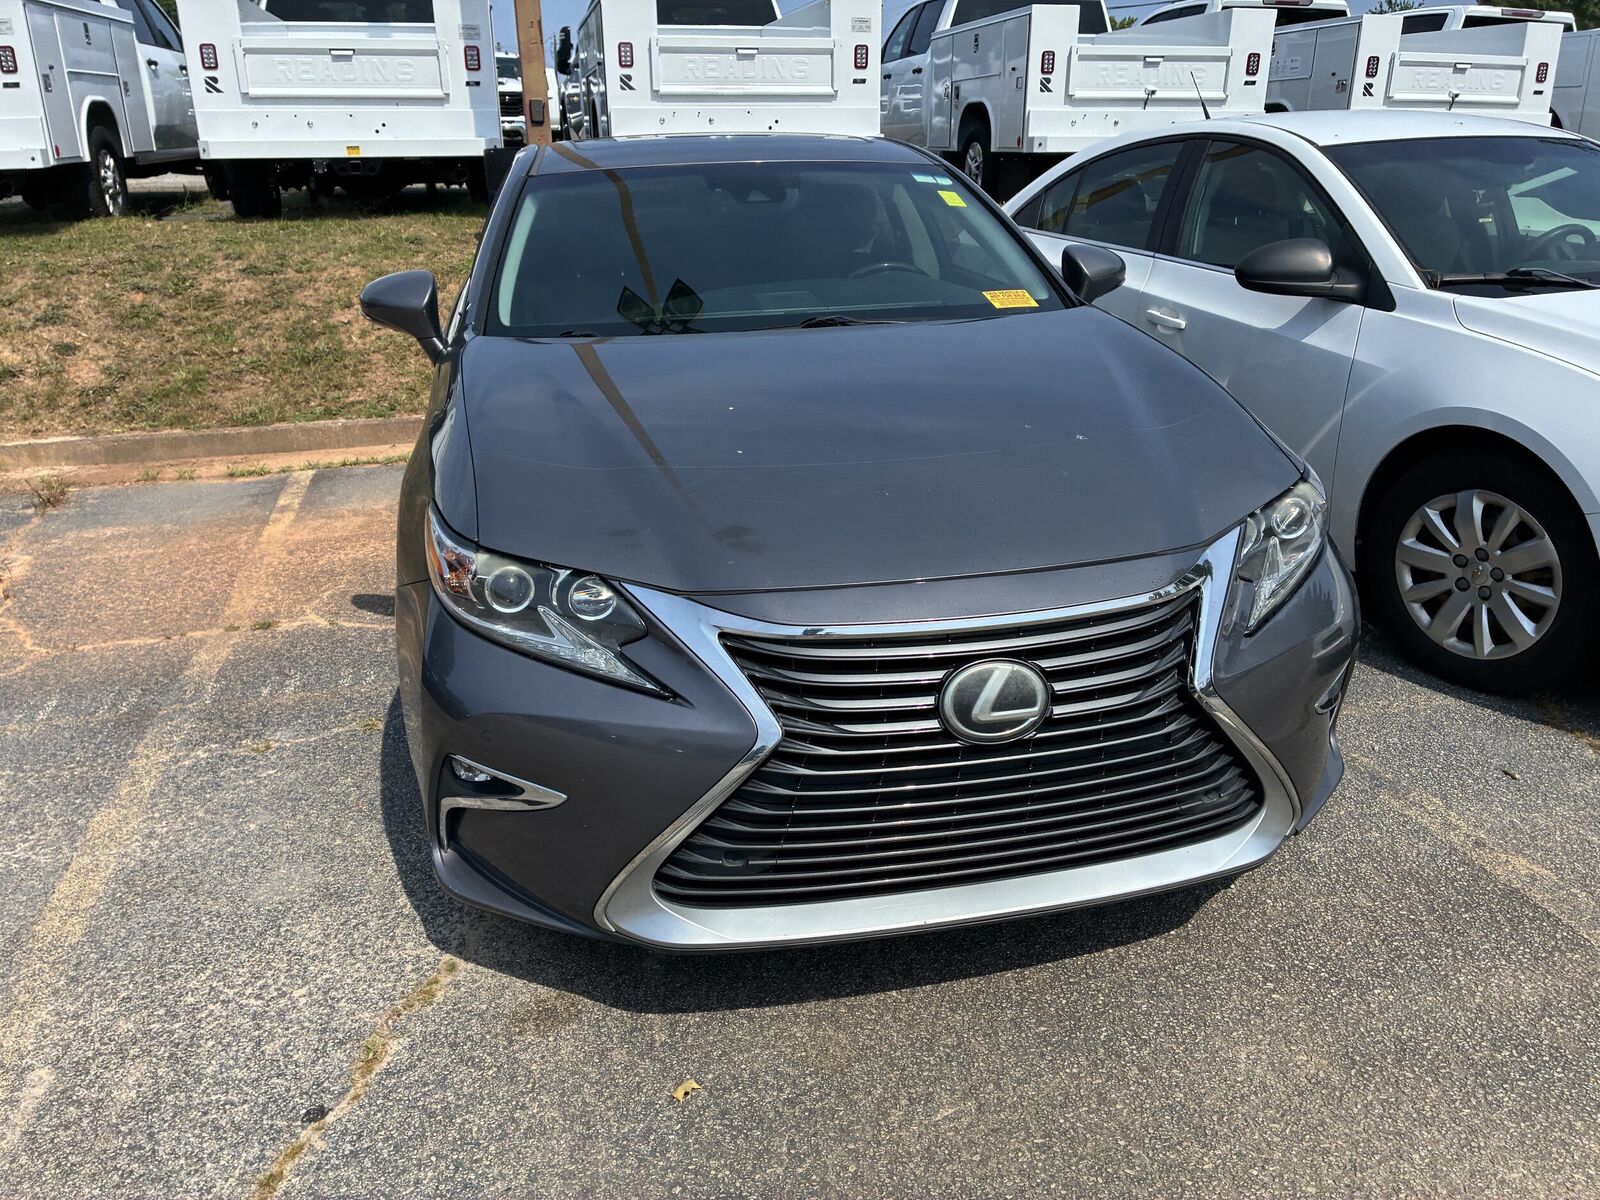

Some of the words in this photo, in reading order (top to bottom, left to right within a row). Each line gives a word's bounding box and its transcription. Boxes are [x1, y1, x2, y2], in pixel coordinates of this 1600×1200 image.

[273, 57, 416, 82] READING
[683, 56, 810, 80] READING
[1096, 63, 1207, 86] READING
[1410, 67, 1505, 90] READING
